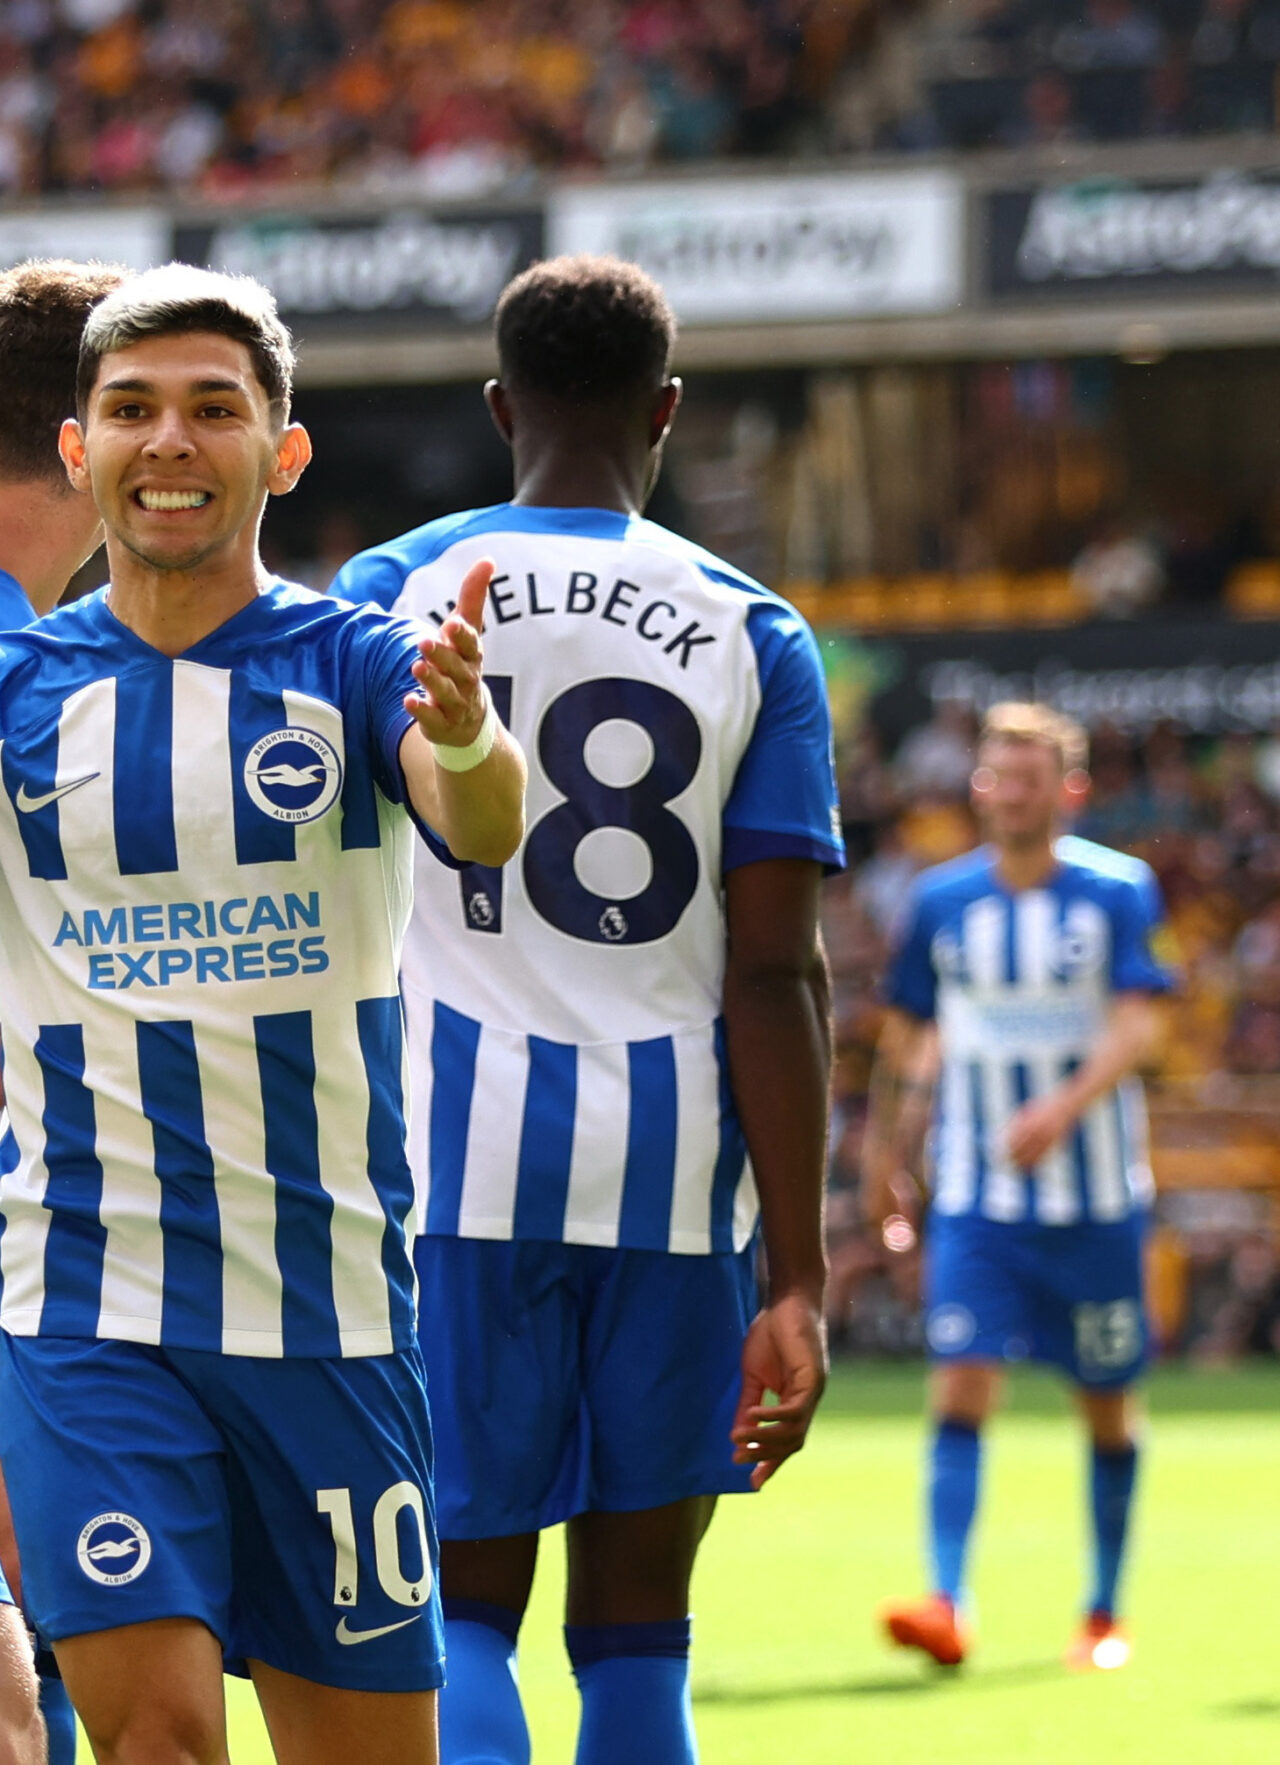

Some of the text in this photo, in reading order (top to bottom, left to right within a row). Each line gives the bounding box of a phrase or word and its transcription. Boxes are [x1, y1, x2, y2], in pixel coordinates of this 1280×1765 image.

[428, 571, 716, 671] ELBECK
[253, 732, 329, 757] BRIGHTON & HOVE
[273, 809, 309, 820] ALBION
[52, 891, 320, 947] AMERICAN
[87, 936, 330, 989] EXPRESS
[317, 1480, 432, 1607] 10
